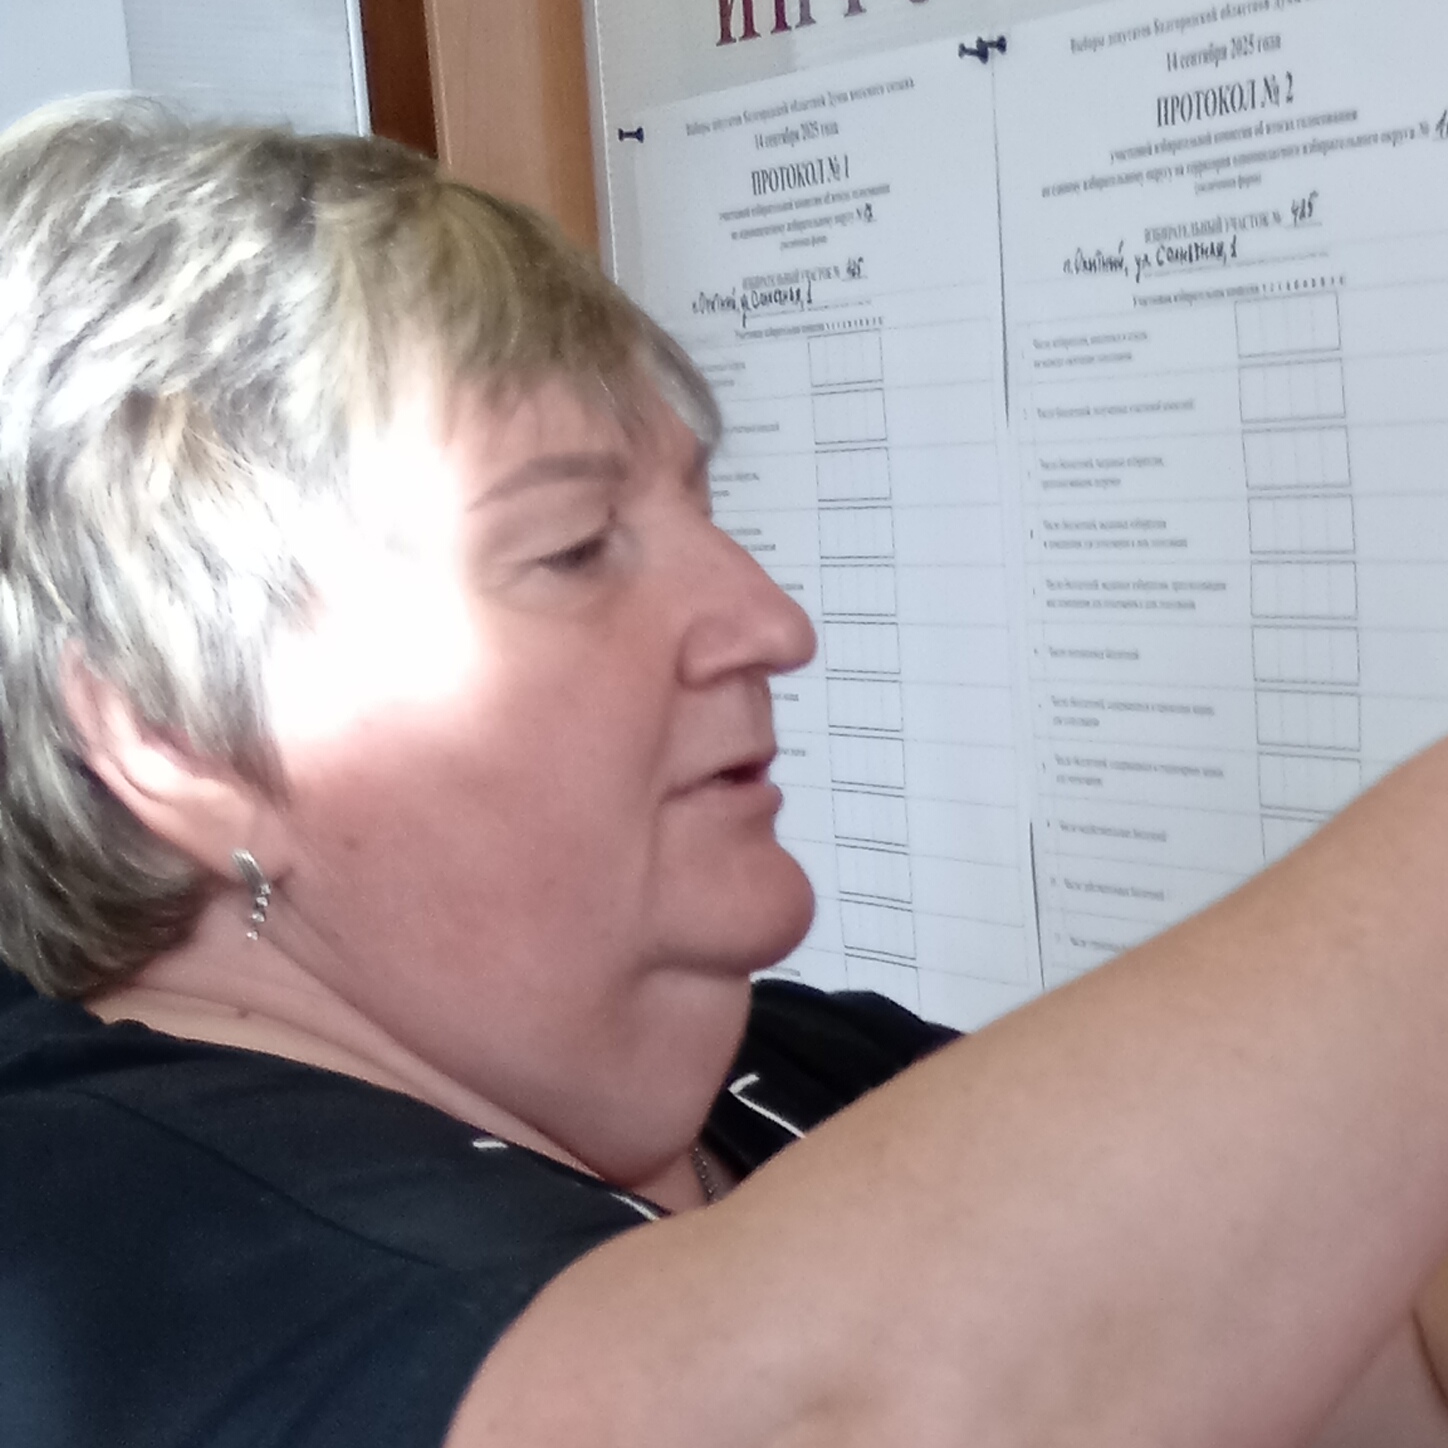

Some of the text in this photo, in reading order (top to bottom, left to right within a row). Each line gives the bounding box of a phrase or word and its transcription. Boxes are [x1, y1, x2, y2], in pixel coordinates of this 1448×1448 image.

[1166, 51, 1179, 72] 14
[1156, 70, 1294, 128] ПРОТОКОЛ № 2
[751, 158, 824, 196] ПРОТОКОЛ
[844, 154, 850, 179] 1
